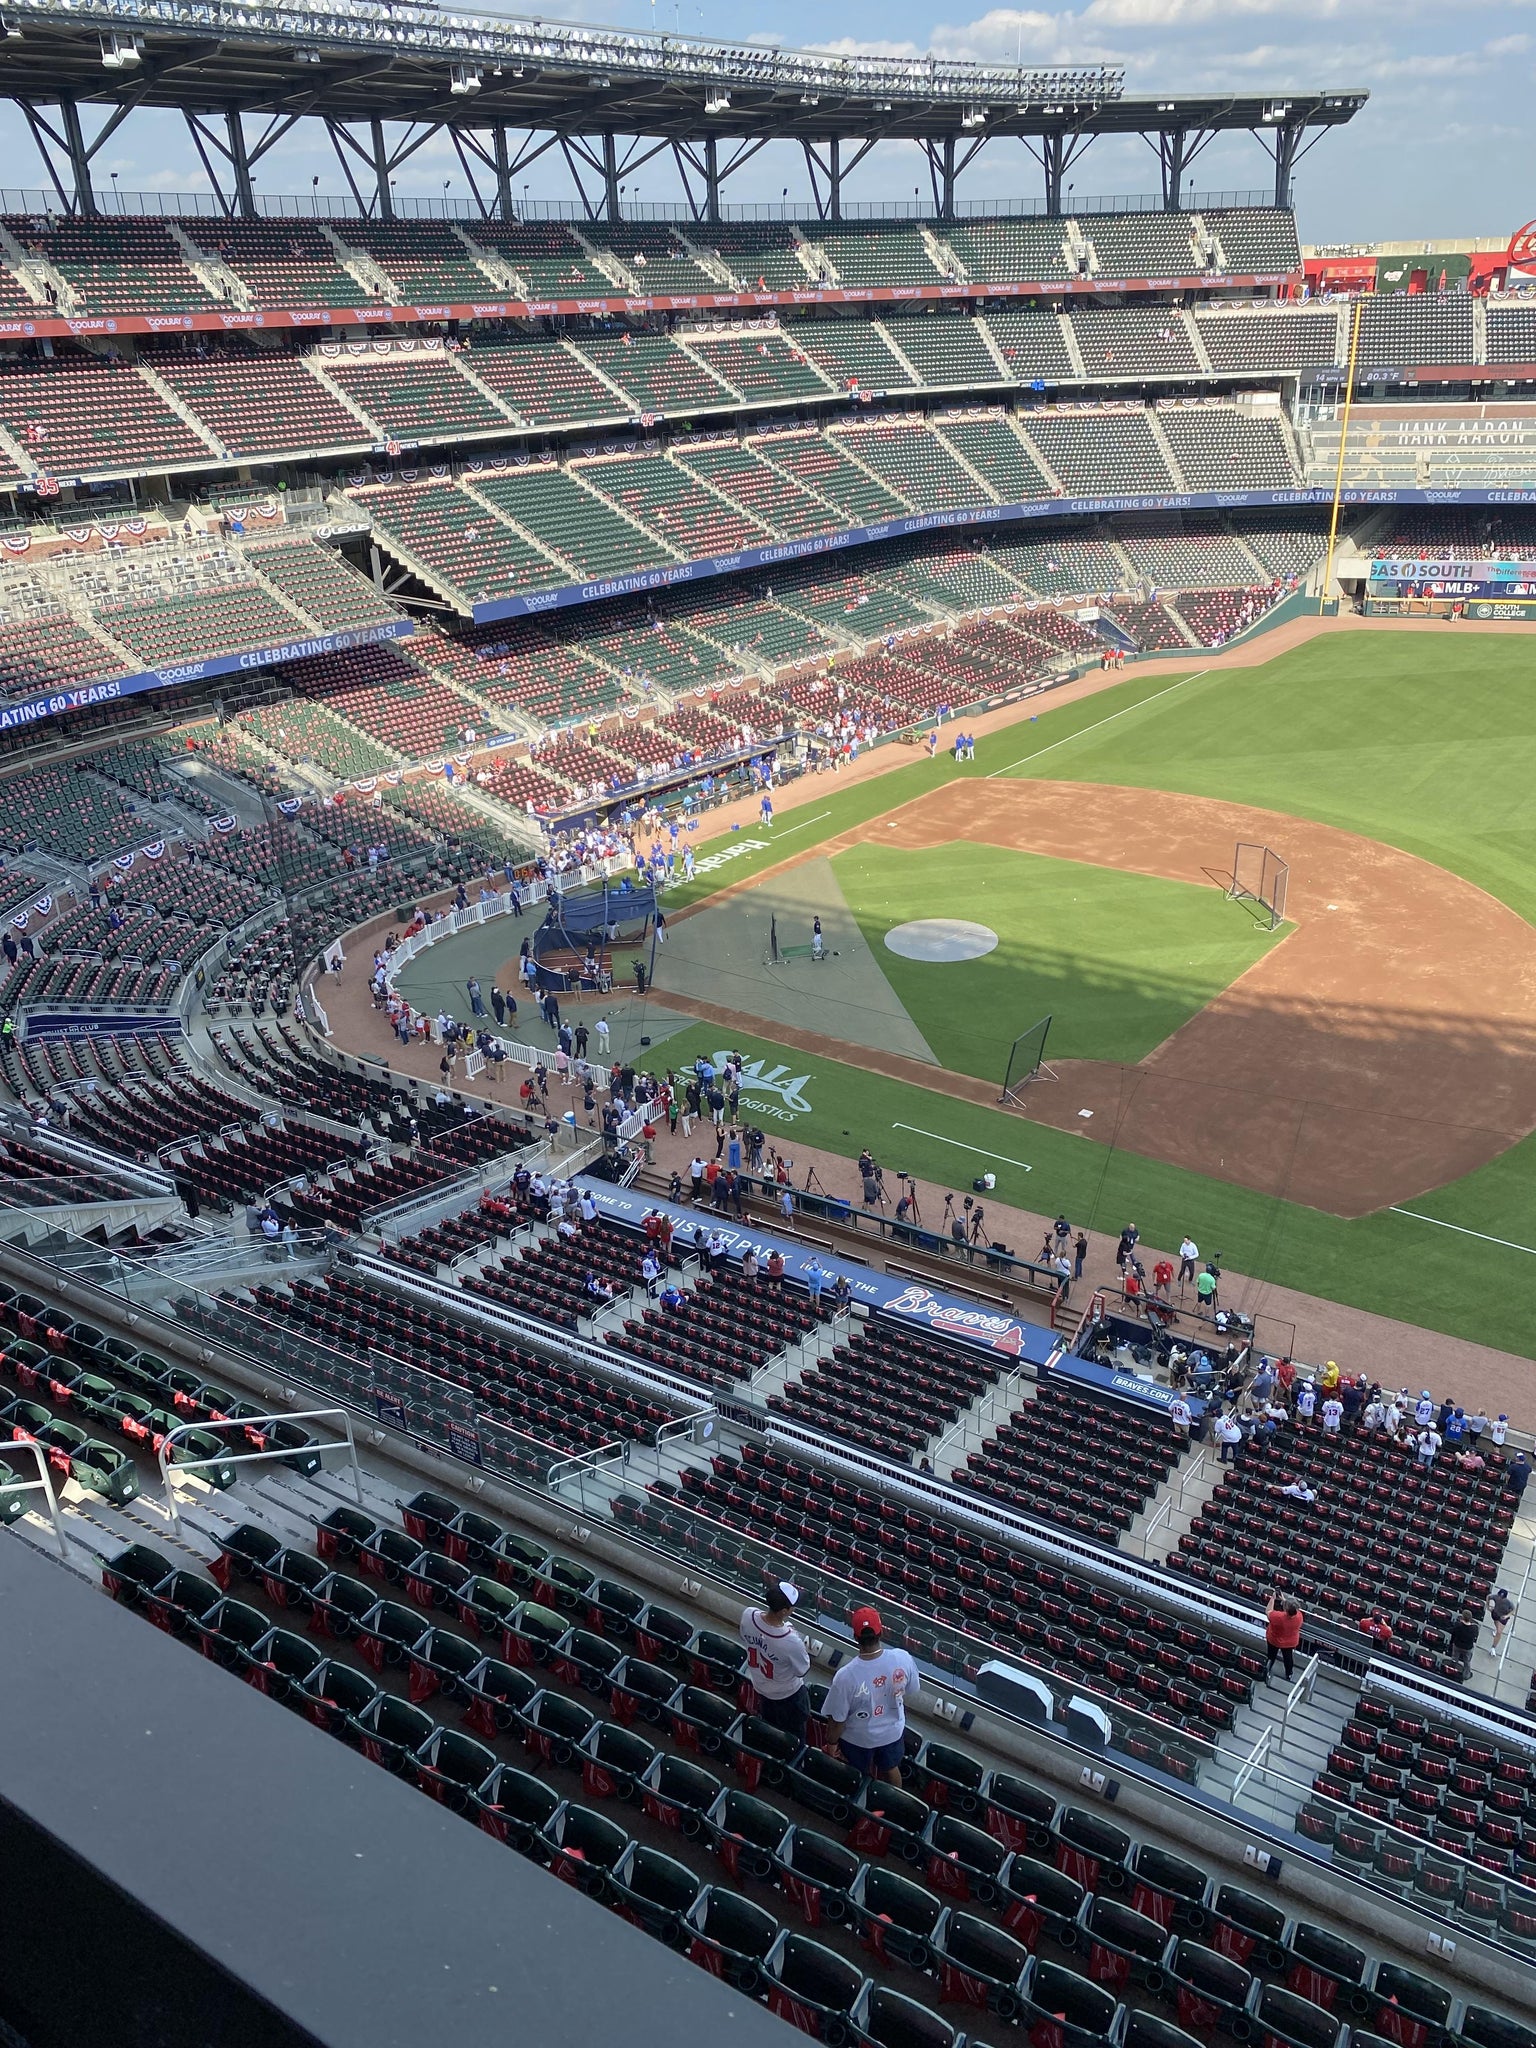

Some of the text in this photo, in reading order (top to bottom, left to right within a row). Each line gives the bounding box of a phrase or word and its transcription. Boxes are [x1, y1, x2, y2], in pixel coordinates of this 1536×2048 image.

[1366, 372, 1388, 381] 80.3
[641, 413, 655, 427] 44
[1398, 420, 1526, 445] HANK AARON
[386, 440, 401, 455] 41
[35, 477, 60, 496] 35
[1217, 493, 1249, 502] COOLRAY
[1344, 491, 1357, 501] 60
[1360, 491, 1397, 501] YEARS!
[1426, 491, 1461, 499] COOLRAY
[1071, 496, 1191, 511] CELEBRATING 60 YEARS!
[904, 509, 1000, 531] CELEBRATING 60 YEARS!
[332, 522, 370, 534] LEXUS
[759, 533, 850, 562] CELEBRATING 60 YEARS!
[1418, 565, 1474, 578] SOUTH
[582, 566, 693, 598] CELEBRATING 60 YEARS!
[1444, 582, 1480, 594] MLB+
[526, 593, 558, 606] COOLRAY
[239, 625, 397, 668] CELEBRATING 60 YEARS!
[159, 663, 205, 680] COOLRAY
[49, 696, 67, 712] 60
[68, 682, 121, 706] YEARS!
[738, 1097, 799, 1122] OGISTICS
[618, 1201, 632, 1210] TO
[855, 1280, 879, 1295] THE
[883, 1286, 1013, 1331] Braves
[1116, 1378, 1169, 1401] BRAVES.COM
[1174, 1406, 1183, 1416] 13
[1328, 1408, 1338, 1416] 13
[450, 1423, 476, 1439] CAUTION
[747, 1646, 774, 1680] 13
